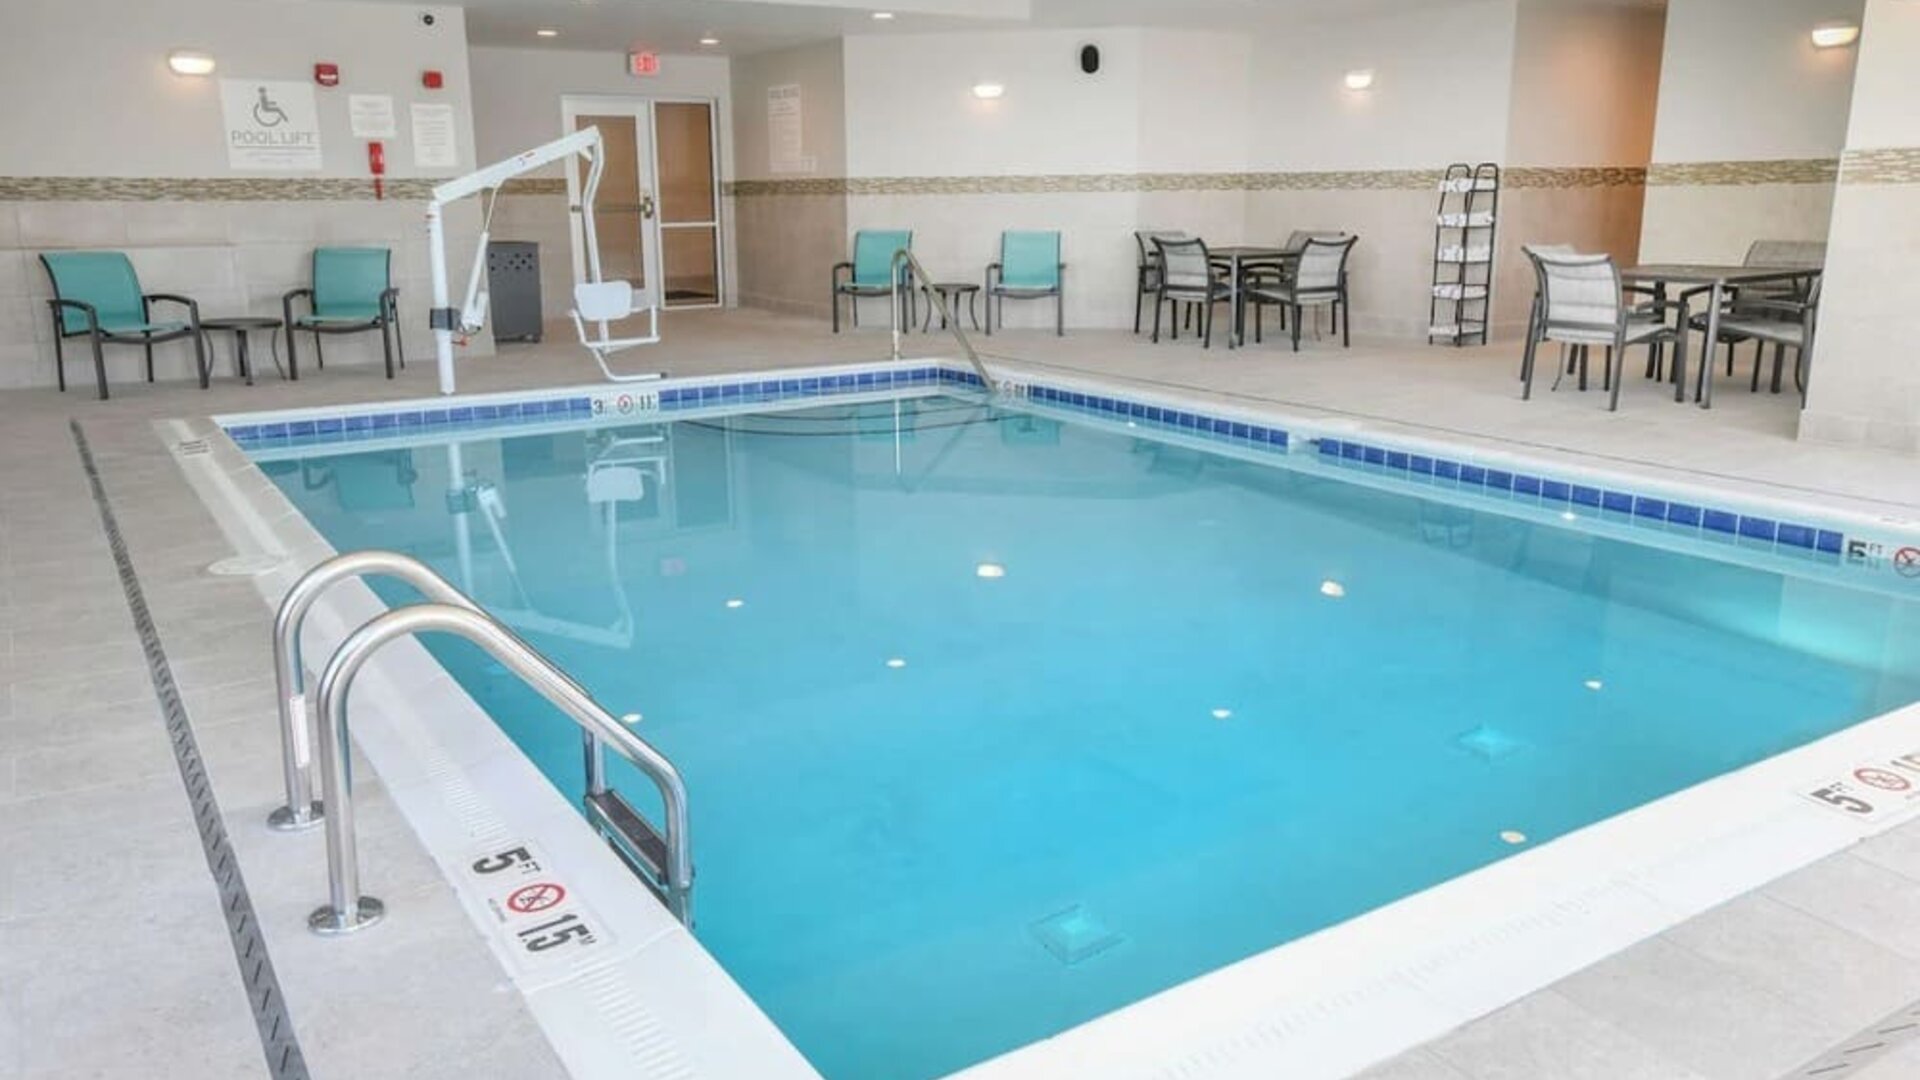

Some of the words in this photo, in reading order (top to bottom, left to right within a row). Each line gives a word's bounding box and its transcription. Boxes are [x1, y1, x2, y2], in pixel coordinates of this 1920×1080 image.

[231, 130, 279, 145] POOL
[281, 131, 316, 145] LIFT
[1847, 539, 1867, 564] 5
[1810, 788, 1874, 814] 5
[472, 847, 531, 874] 5
